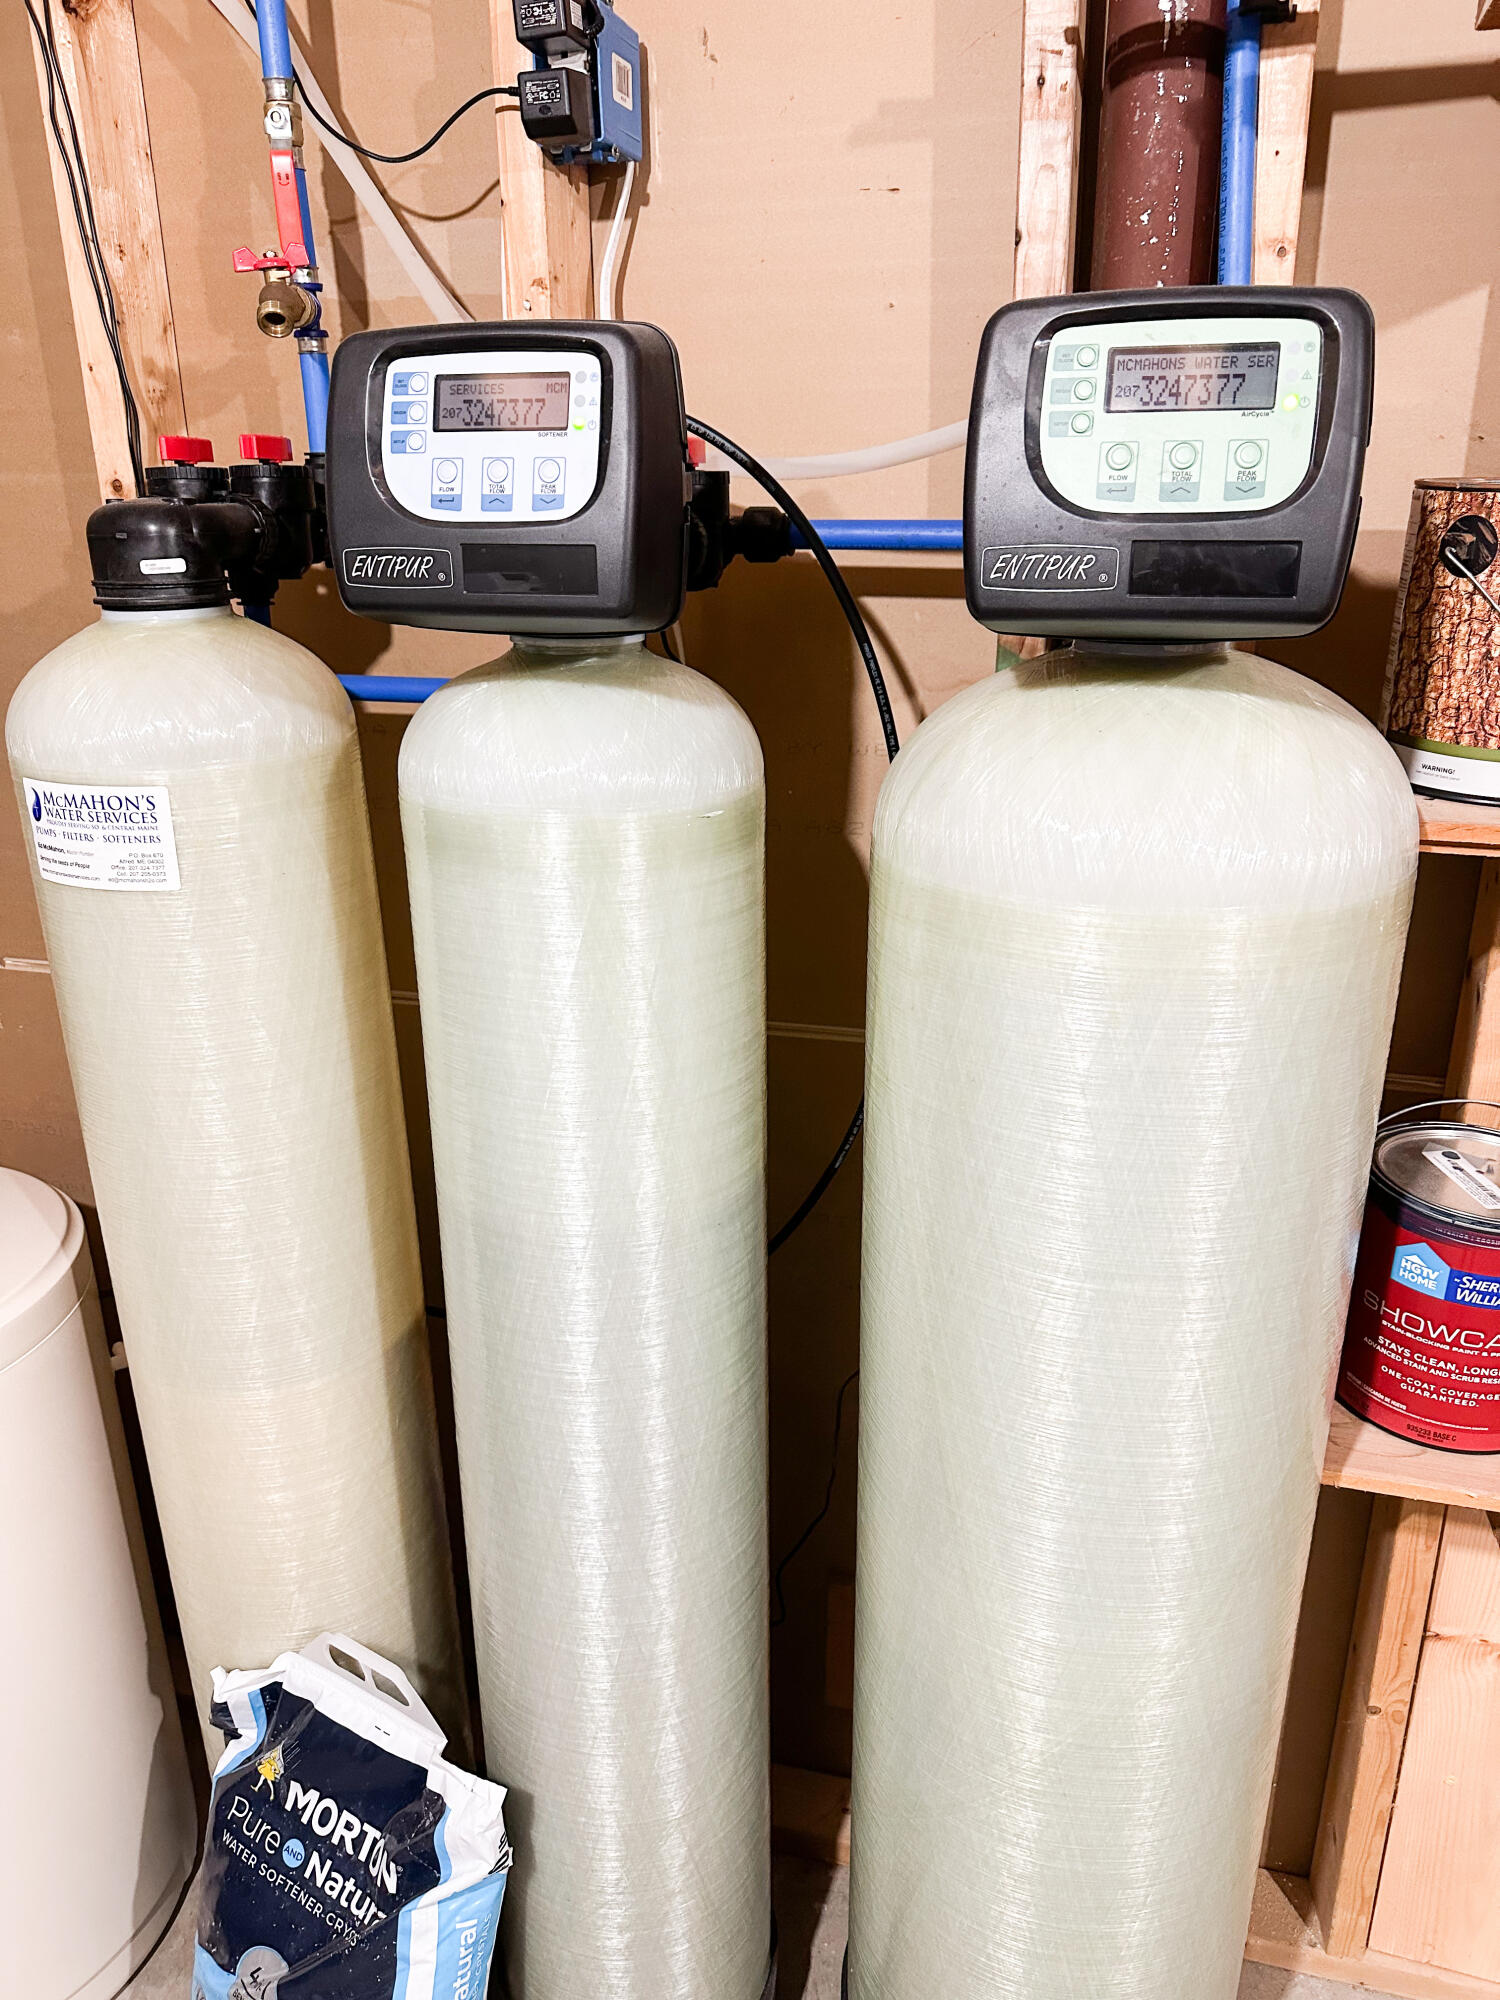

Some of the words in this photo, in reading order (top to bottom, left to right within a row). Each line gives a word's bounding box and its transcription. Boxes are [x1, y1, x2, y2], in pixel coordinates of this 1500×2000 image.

[1117, 356, 1186, 370] MCMAHONS
[1195, 355, 1238, 369] WATER
[1247, 354, 1275, 368] SER
[449, 384, 505, 395] SERVICES
[1114, 385, 1141, 399] 207
[1139, 373, 1246, 406] 3247377
[441, 407, 462, 419] 207
[461, 397, 547, 426] 3247377
[351, 555, 434, 579] ENTIPUR
[989, 553, 1096, 580] ENTIPUR
[1421, 763, 1456, 775] WARNING!
[44, 805, 85, 823] WATER
[87, 811, 158, 825] SERVICES
[36, 825, 57, 838] PUMPS
[62, 830, 95, 843] FILTERS
[102, 834, 162, 845] SOFTENERS
[1399, 1267, 1438, 1291] HOME
[1400, 1258, 1440, 1280] HGTV
[1363, 1336, 1402, 1363] ADVANCED
[1403, 1358, 1428, 1373] STAIN
[1428, 1367, 1449, 1379] AND
[1450, 1372, 1480, 1384] SCRUB
[1377, 1335, 1412, 1358] STAYS
[1413, 1352, 1460, 1374] CLEAN,
[1451, 1346, 1481, 1357] PAINT
[1380, 1364, 1437, 1392] ONE-COAT
[1399, 1382, 1480, 1408] GUARANTEED.
[1432, 1430, 1450, 1441] BASE
[226, 1795, 281, 1856] Pure
[284, 1845, 303, 1863] AND
[284, 1780, 398, 1895] MORTON
[222, 1828, 258, 1868] WATER
